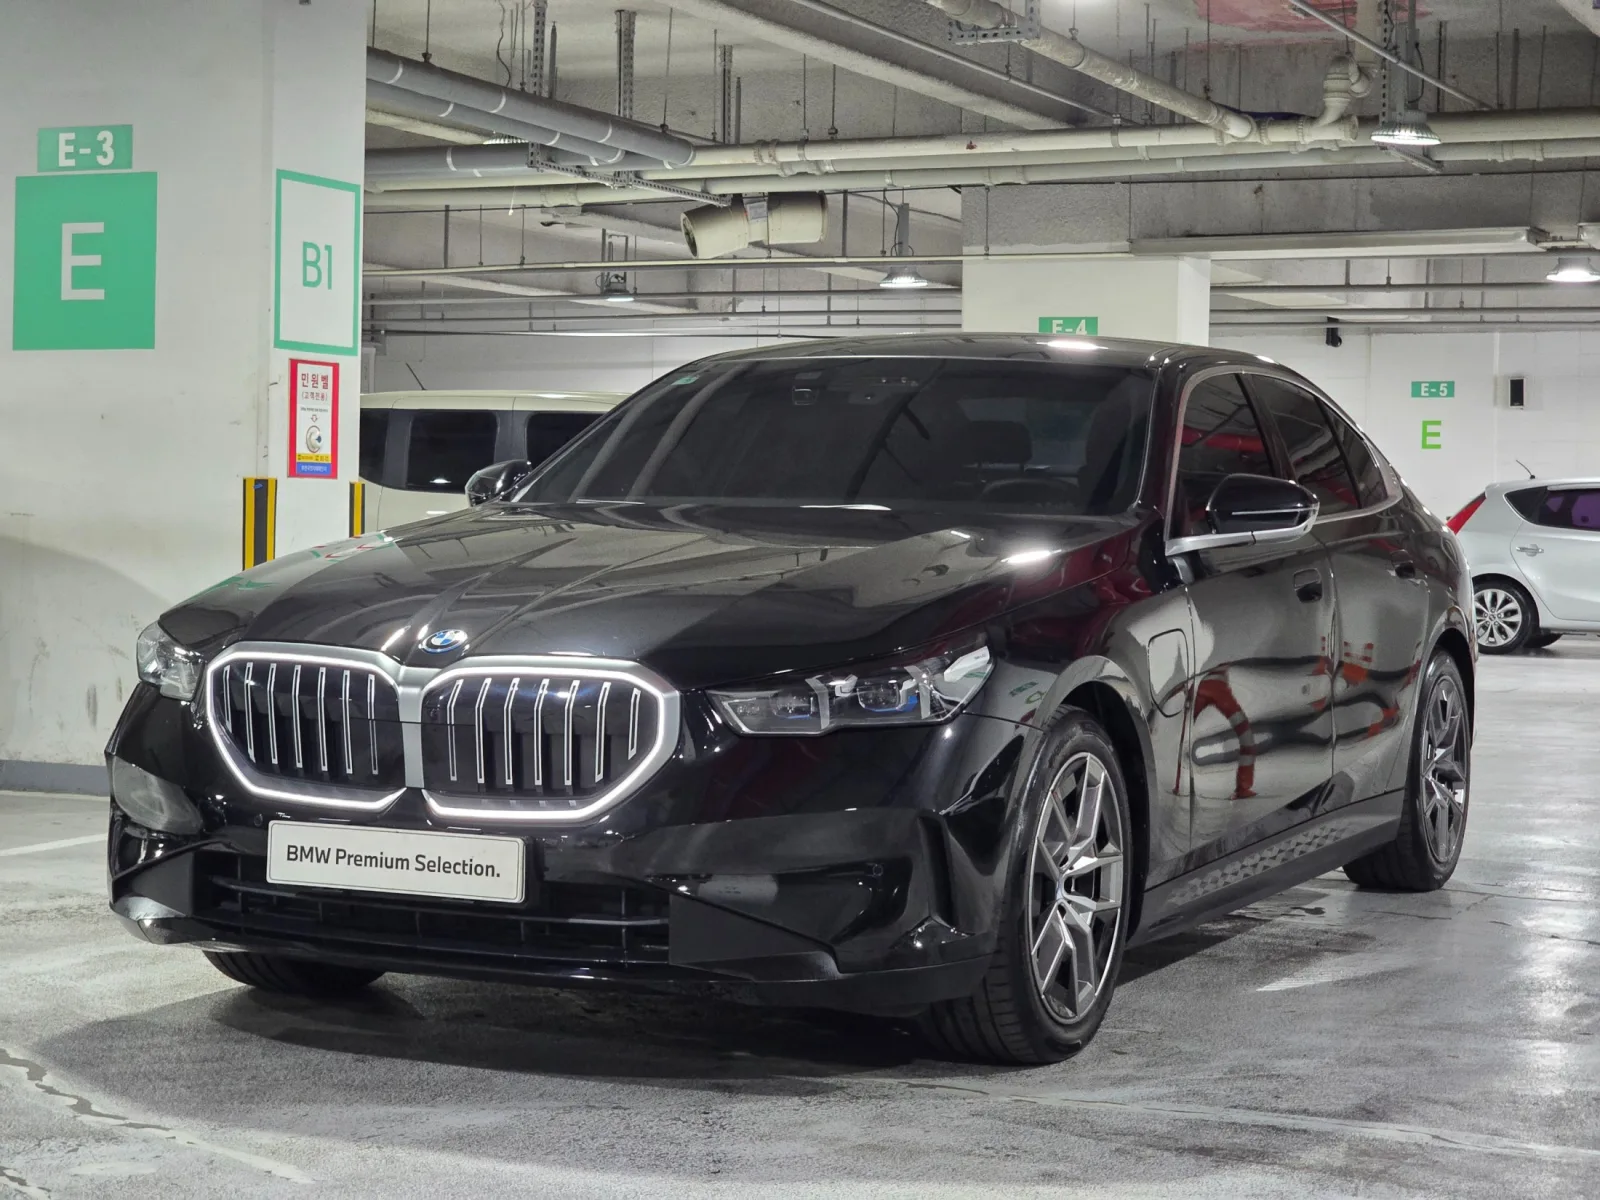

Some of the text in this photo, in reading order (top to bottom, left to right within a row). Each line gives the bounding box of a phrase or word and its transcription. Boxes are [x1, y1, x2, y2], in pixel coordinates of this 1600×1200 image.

[58, 130, 115, 167] E-3
[61, 221, 105, 301] E
[302, 241, 333, 290] B1
[1052, 319, 1088, 335] E-4
[1420, 383, 1448, 397] E-5
[1421, 420, 1442, 449] E
[286, 844, 501, 877] BMW Premium Selection.
